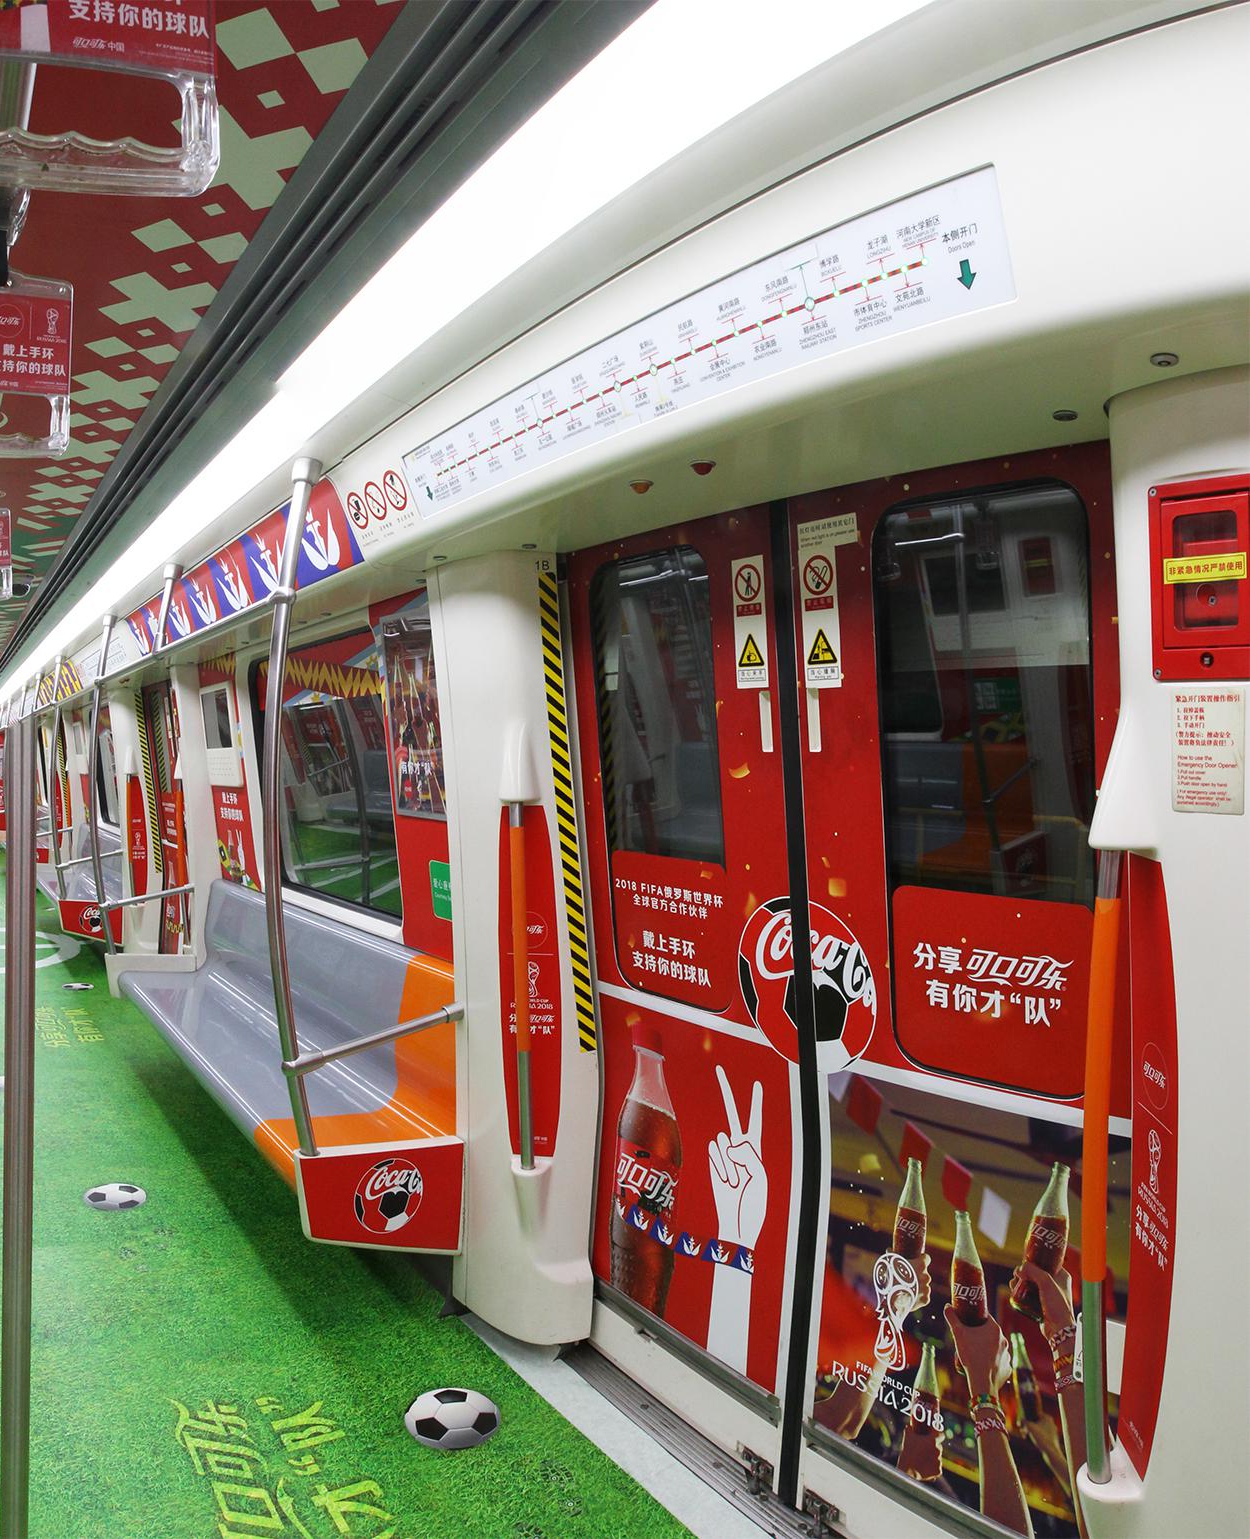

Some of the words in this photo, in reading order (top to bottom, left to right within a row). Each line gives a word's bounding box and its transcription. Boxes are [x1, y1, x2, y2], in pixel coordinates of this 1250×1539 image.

[69, 0, 210, 39] 支持你的球队
[942, 223, 978, 243] 本侧开门
[2, 343, 54, 360] 戴上手环
[535, 560, 550, 570] 1B
[1169, 560, 1243, 576] 非紧急情况严禁使用
[615, 878, 637, 891] 2018
[641, 883, 723, 909] FIFA俄罗斯世界杯
[633, 894, 708, 919] 全球官方合作伙伴
[642, 931, 696, 960] 戴上手环
[632, 951, 711, 989] 支持你的球队
[913, 942, 1074, 992] 分享可口可乐
[925, 979, 1061, 1028] 有你才“队”
[617, 1152, 679, 1210] 可口可乐
[856, 1361, 873, 1375] FIFA
[903, 1385, 921, 1399] CUP
[901, 1396, 945, 1433] 2018
